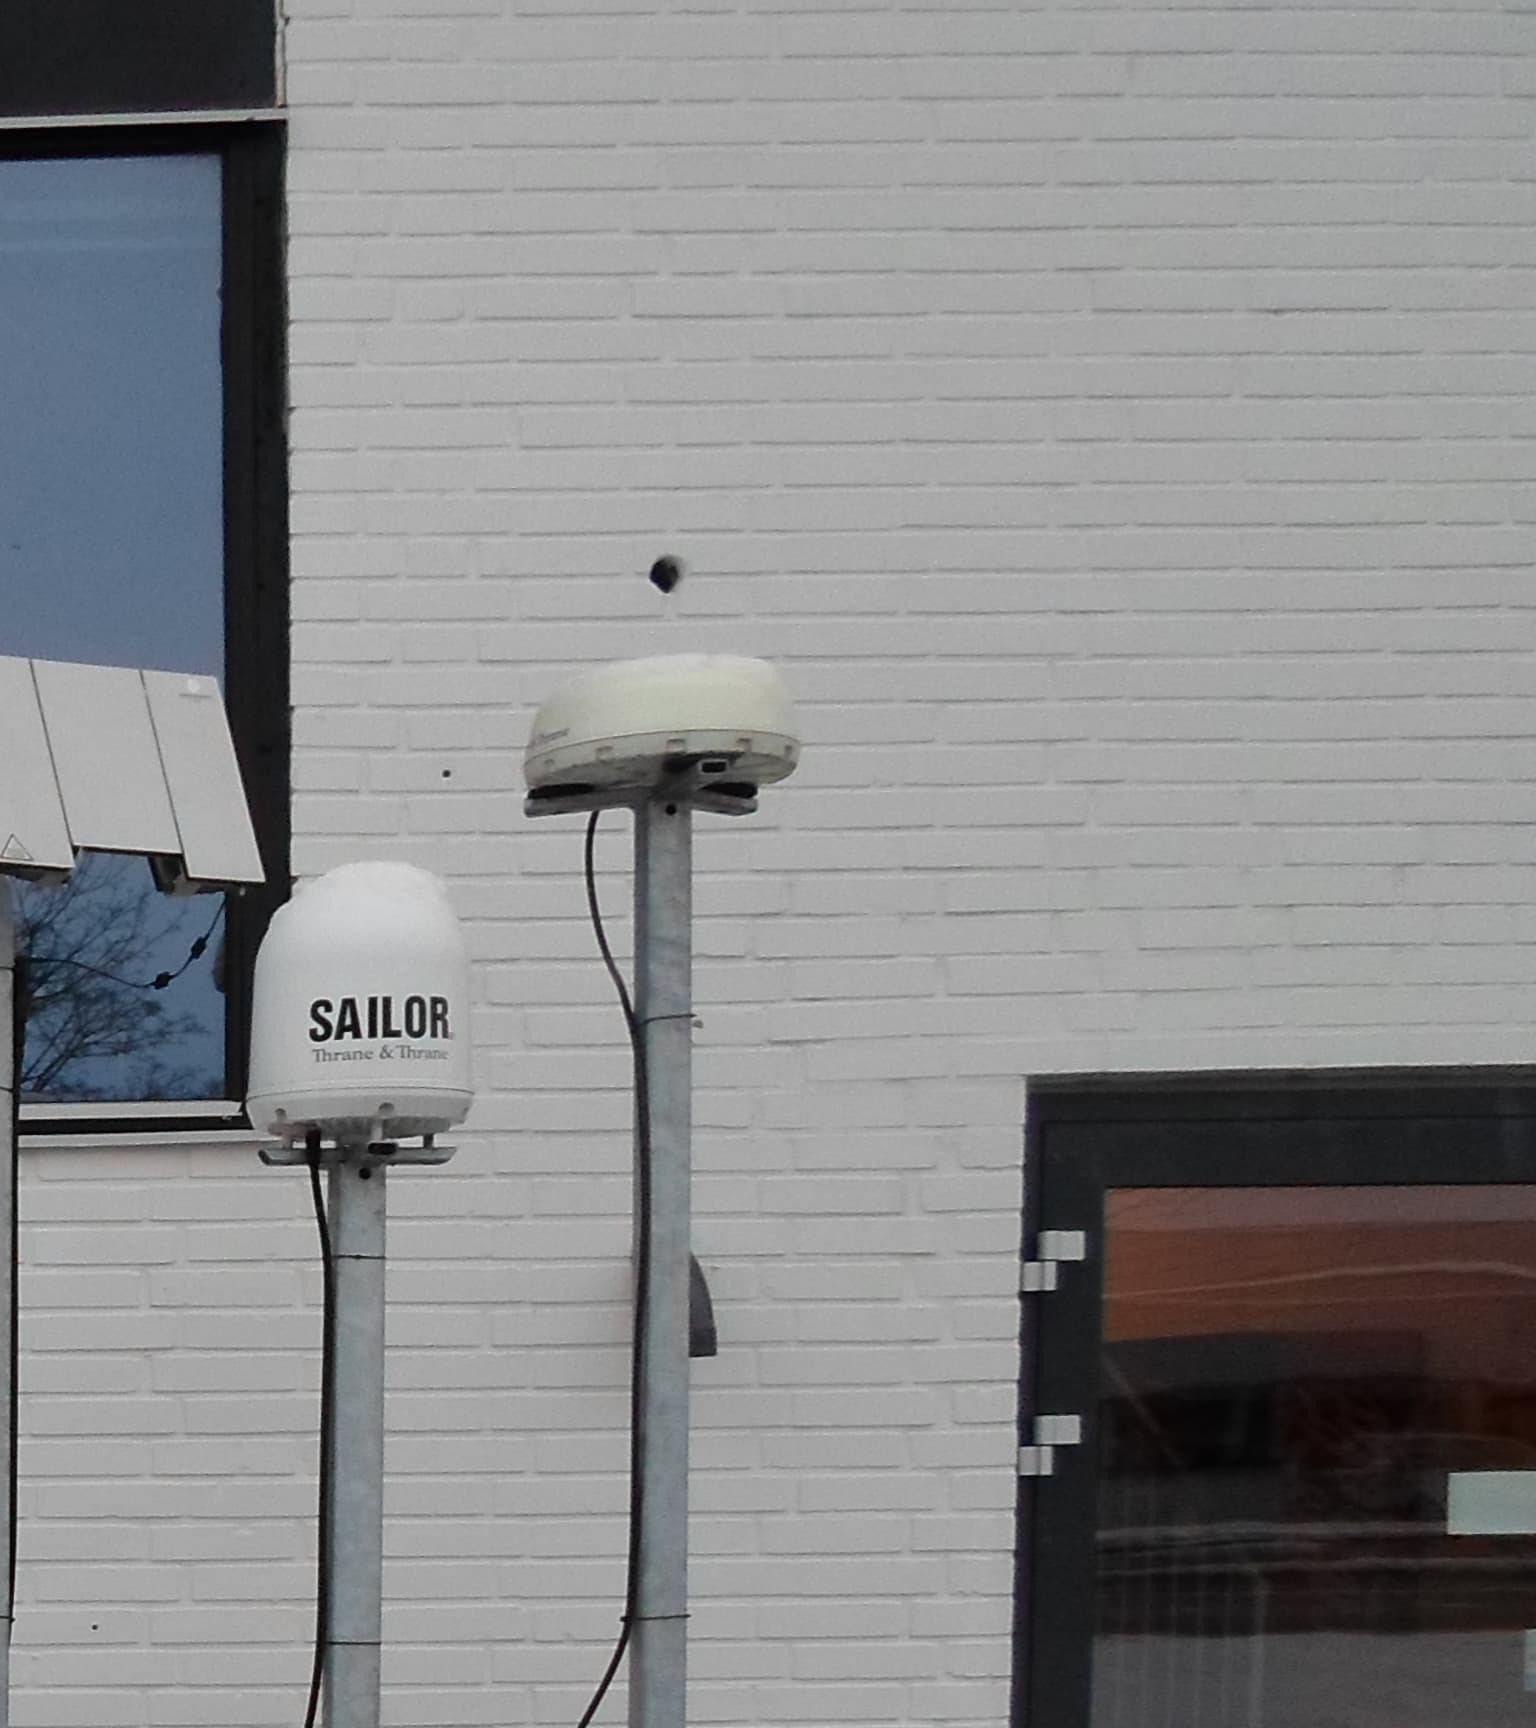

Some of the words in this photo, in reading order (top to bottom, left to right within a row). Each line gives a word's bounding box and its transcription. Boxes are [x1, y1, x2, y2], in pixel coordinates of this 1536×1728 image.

[309, 995, 449, 1042] SAILOR
[312, 1048, 374, 1063] Thrane
[379, 1044, 393, 1060] &
[395, 1044, 449, 1060] Thrane
